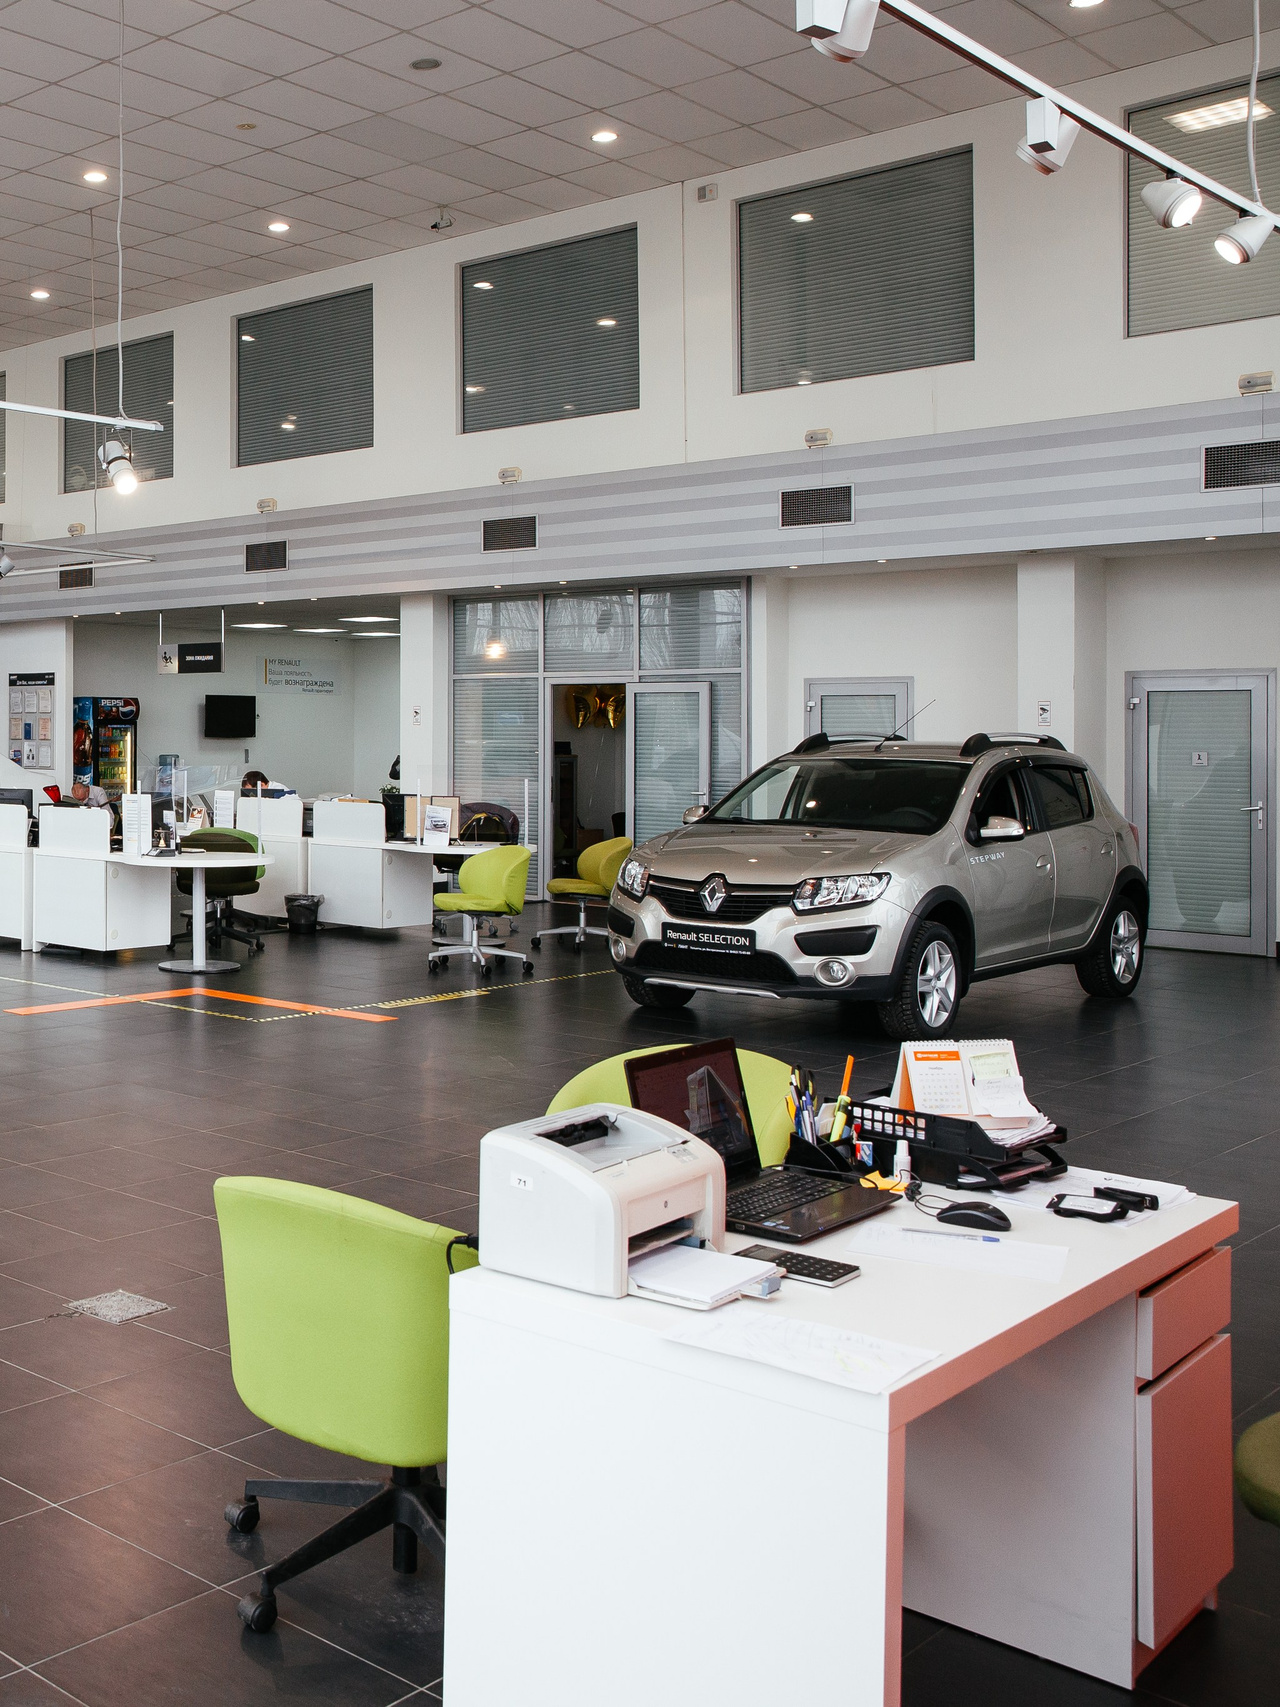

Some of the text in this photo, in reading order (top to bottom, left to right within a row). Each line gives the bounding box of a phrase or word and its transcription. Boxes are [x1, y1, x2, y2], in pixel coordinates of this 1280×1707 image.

[284, 679, 334, 688] вознаграждена
[970, 852, 1005, 865] STEPWAY
[666, 930, 749, 946] Renault SELECTION
[517, 1178, 527, 1187] 71
